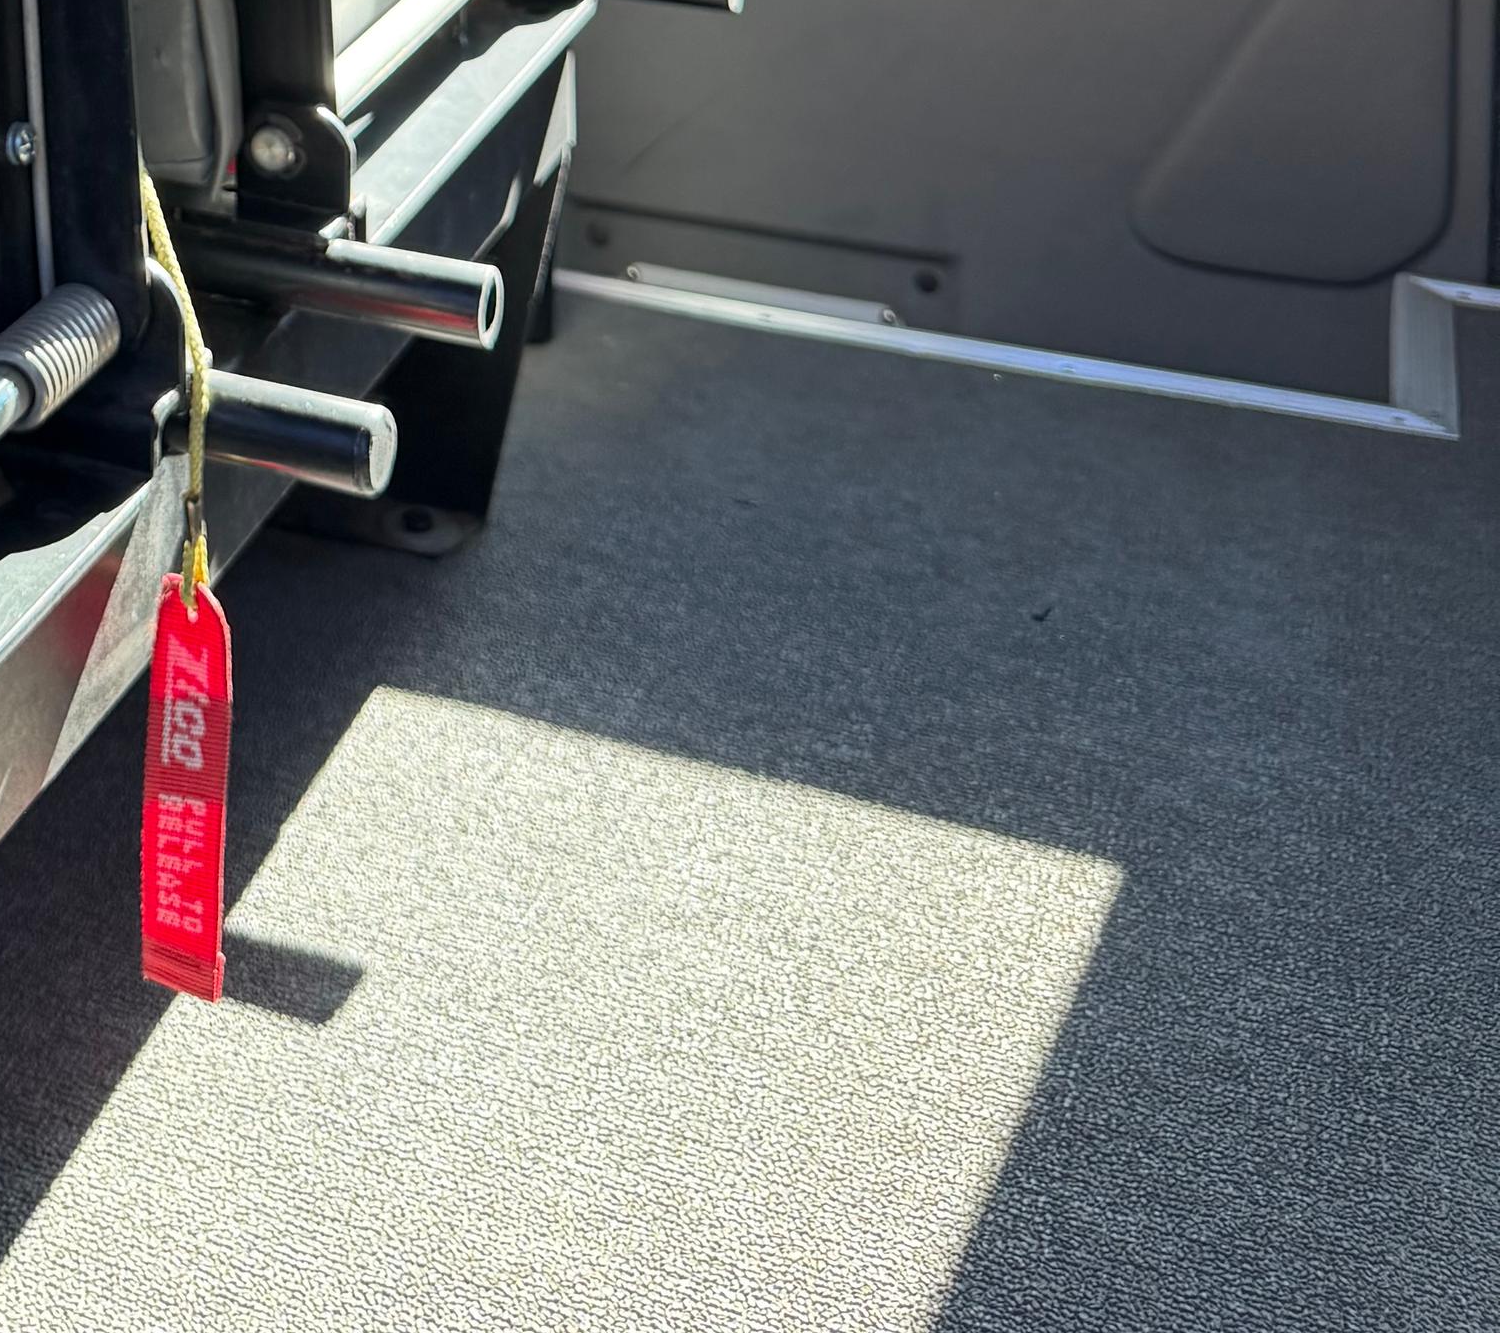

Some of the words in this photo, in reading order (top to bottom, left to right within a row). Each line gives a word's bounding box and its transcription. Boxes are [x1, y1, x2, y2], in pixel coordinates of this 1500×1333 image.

[156, 793, 184, 927] RELEASE
[183, 795, 207, 874] PULL
[182, 898, 203, 934] TO
